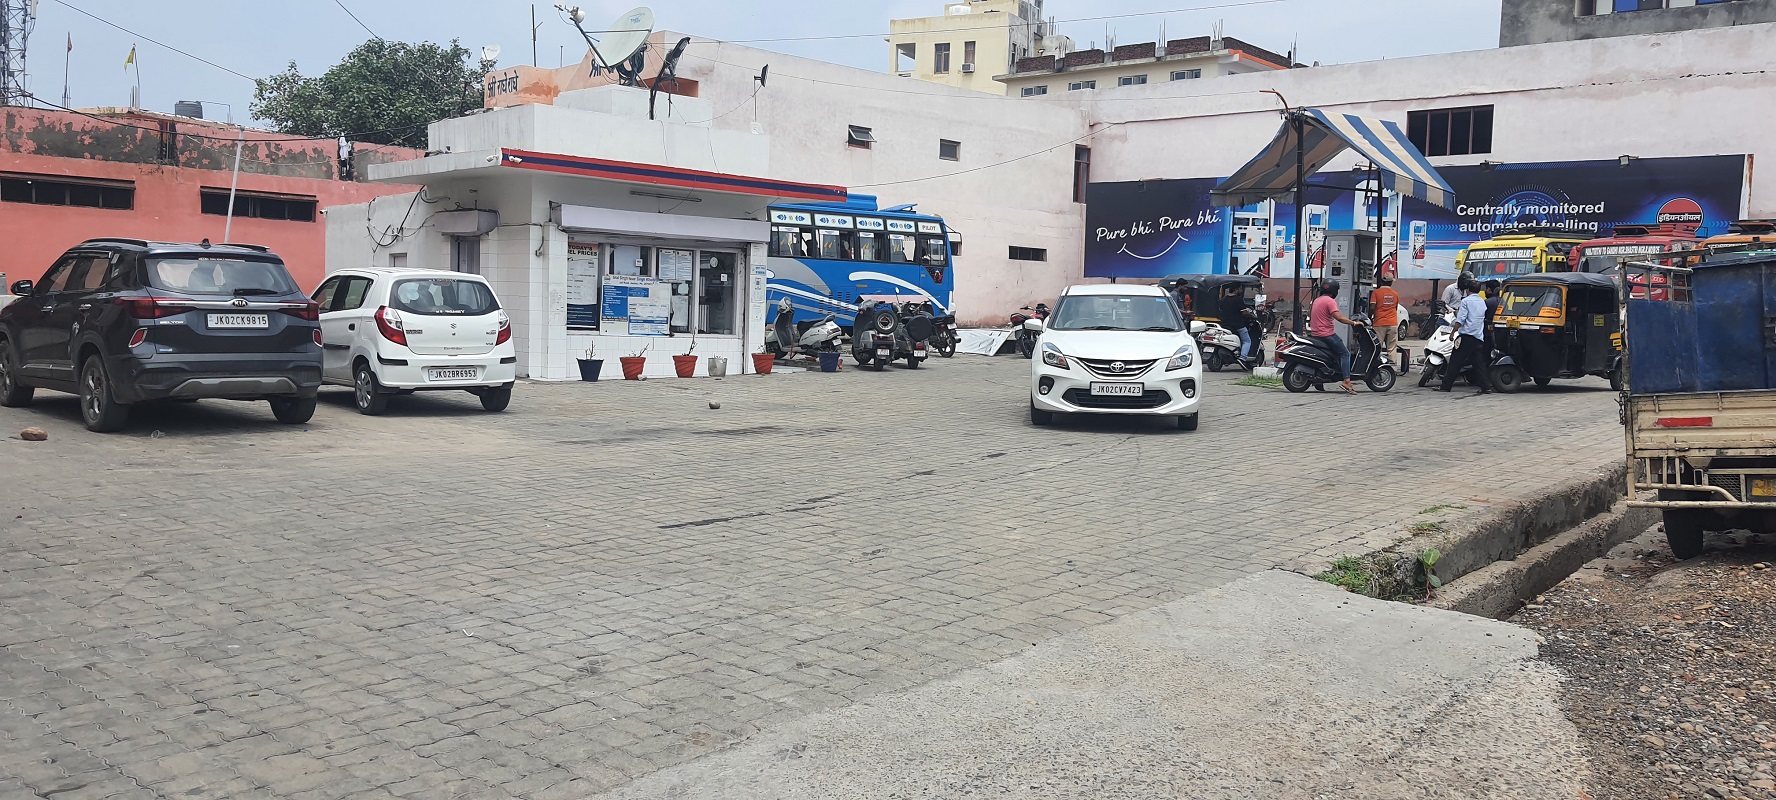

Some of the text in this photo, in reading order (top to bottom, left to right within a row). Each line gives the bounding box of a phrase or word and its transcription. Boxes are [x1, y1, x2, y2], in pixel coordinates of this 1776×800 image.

[1456, 201, 1605, 217] Centrally monitored
[1659, 213, 1701, 222] इंडियनऑयल
[1096, 209, 1222, 242] Pure bhi. Pura bhi.
[1459, 219, 1537, 232] automated
[214, 316, 267, 325] JK02CK9815
[435, 369, 477, 378] JK02BR6953
[1096, 386, 1141, 394] JK02CV7423
